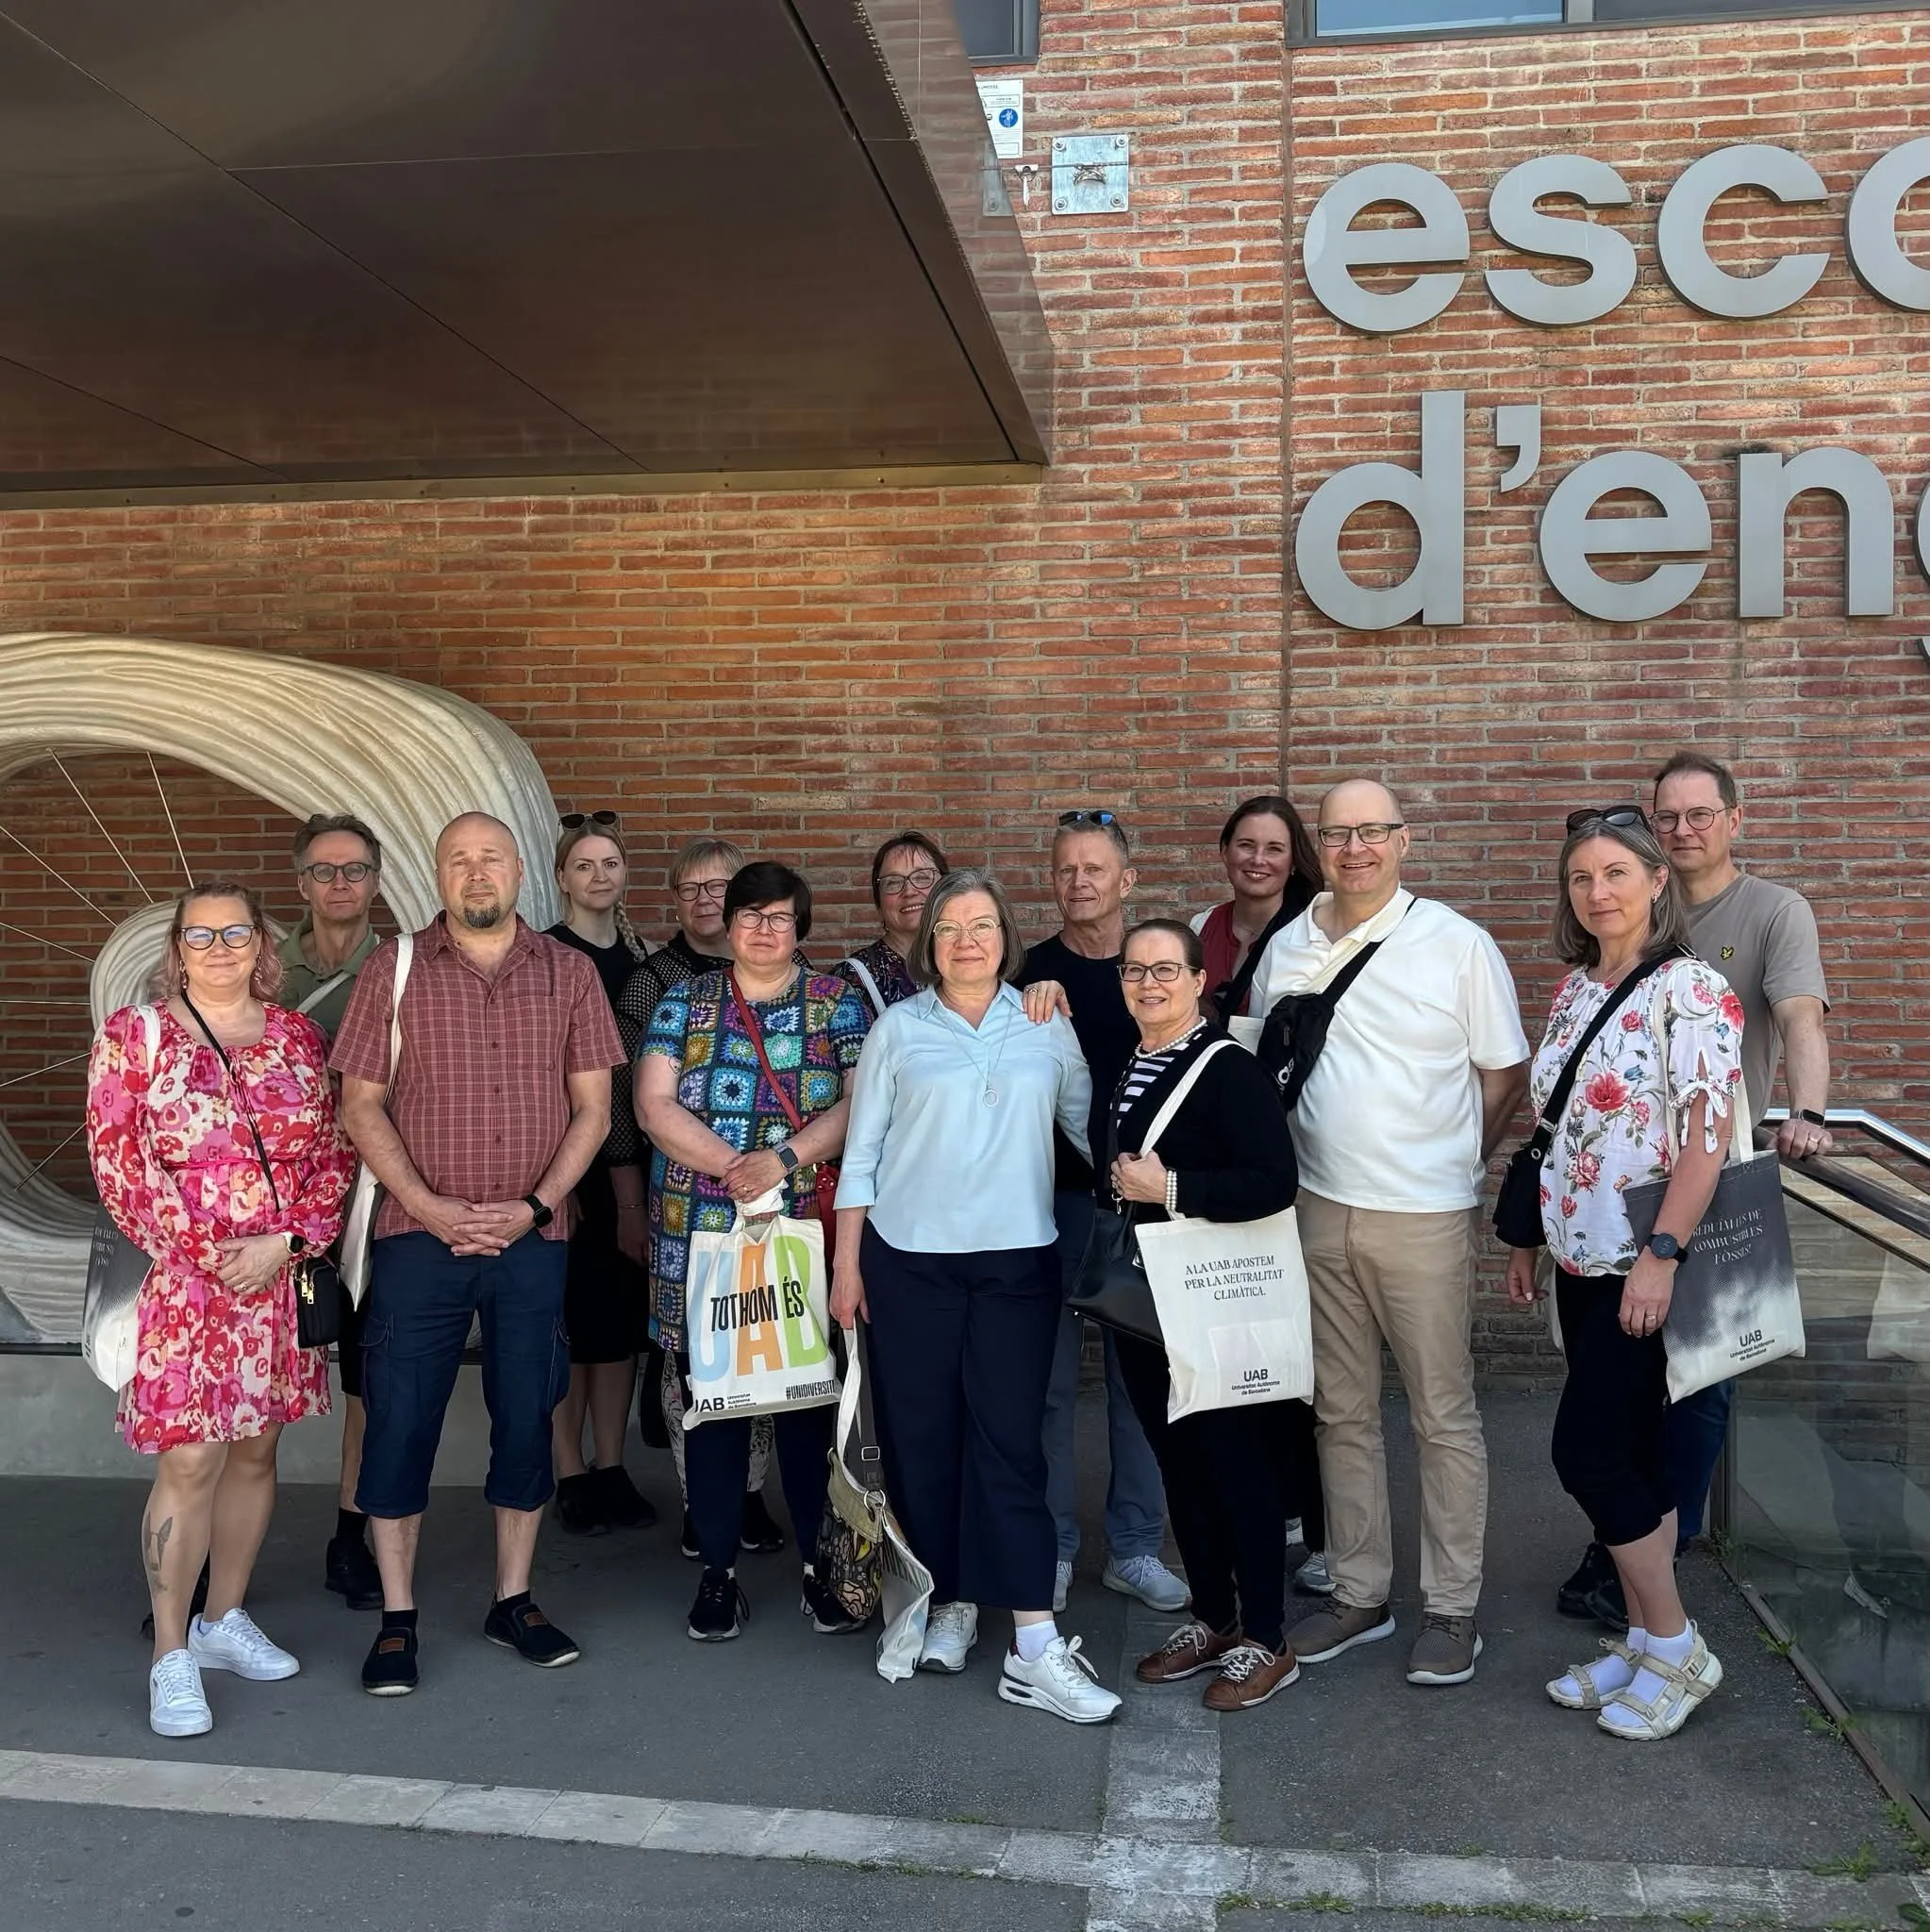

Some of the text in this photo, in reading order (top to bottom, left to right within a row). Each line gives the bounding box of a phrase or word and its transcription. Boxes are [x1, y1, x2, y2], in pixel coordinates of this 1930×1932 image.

[1294, 391, 1930, 668] d'en
[1186, 1256, 1274, 1275] A LA UAB APOSTEM
[1185, 1269, 1285, 1290] PER LA NEUTRALITAT
[1213, 1286, 1267, 1301] CLIMÀTICA.
[710, 1275, 806, 1332] TOTHOM ÉS
[1739, 1329, 1763, 1347] UAB
[1244, 1369, 1268, 1382] UAB
